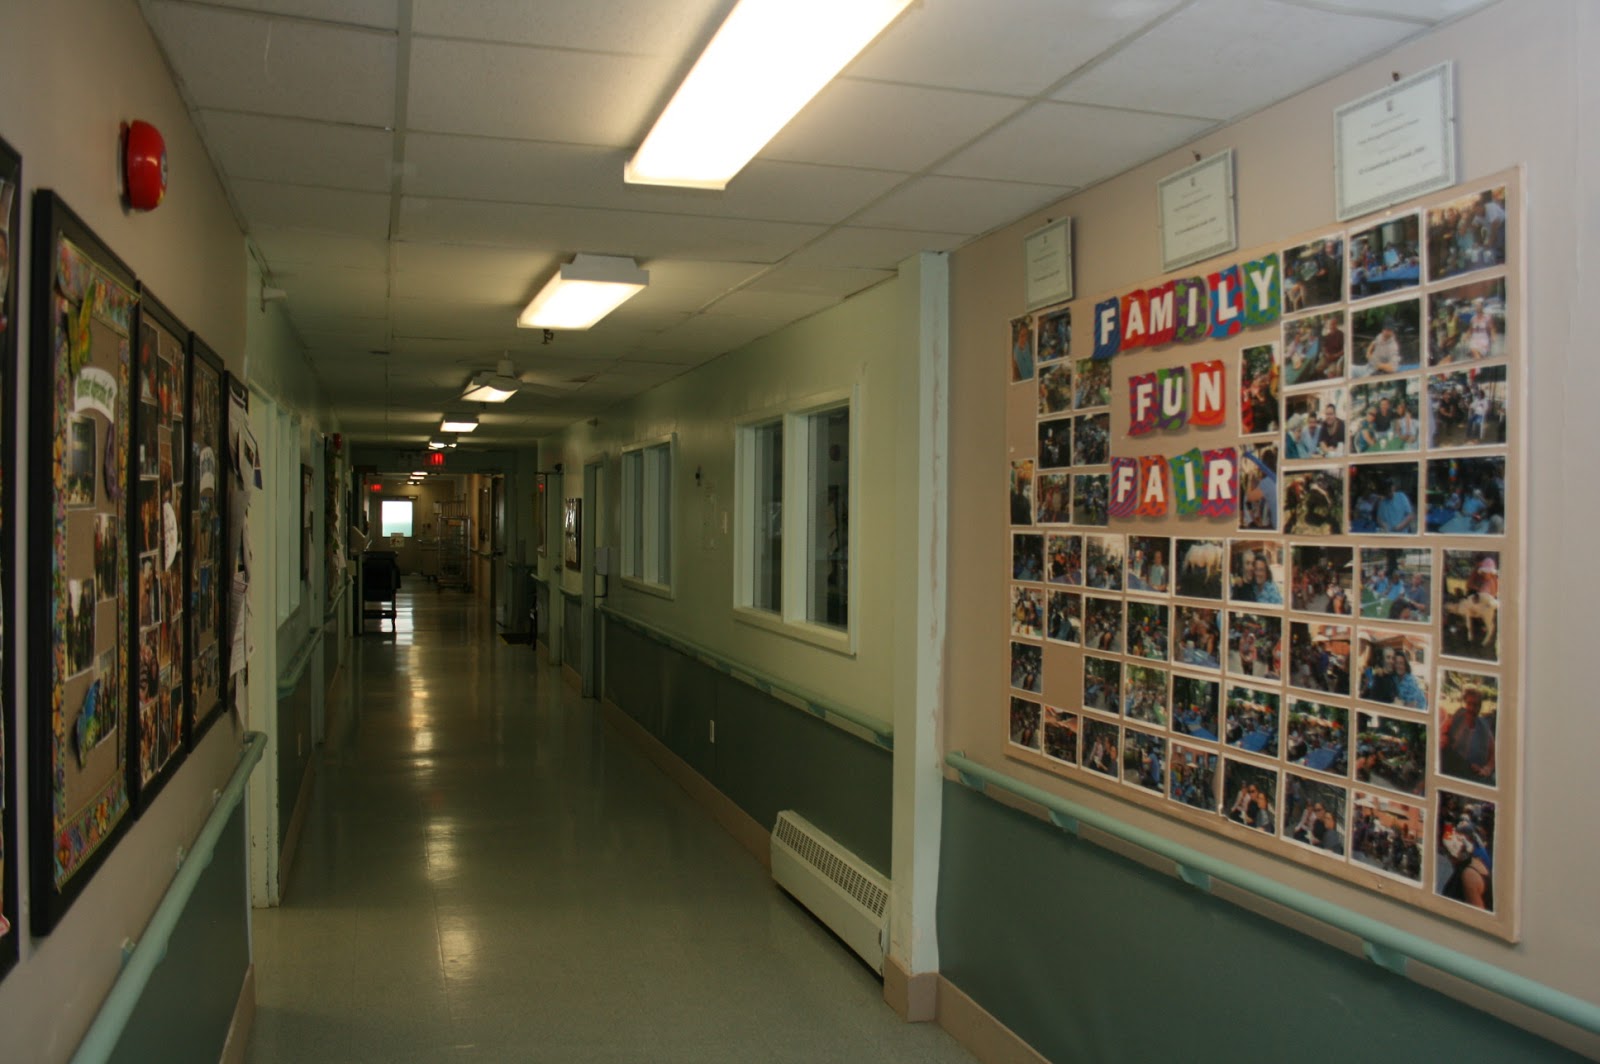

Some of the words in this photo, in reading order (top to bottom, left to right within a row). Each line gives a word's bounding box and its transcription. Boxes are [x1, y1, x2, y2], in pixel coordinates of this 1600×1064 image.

[1100, 265, 1274, 345] FAMILY
[1137, 371, 1221, 422] FUN
[1117, 459, 1232, 503] FAIR
